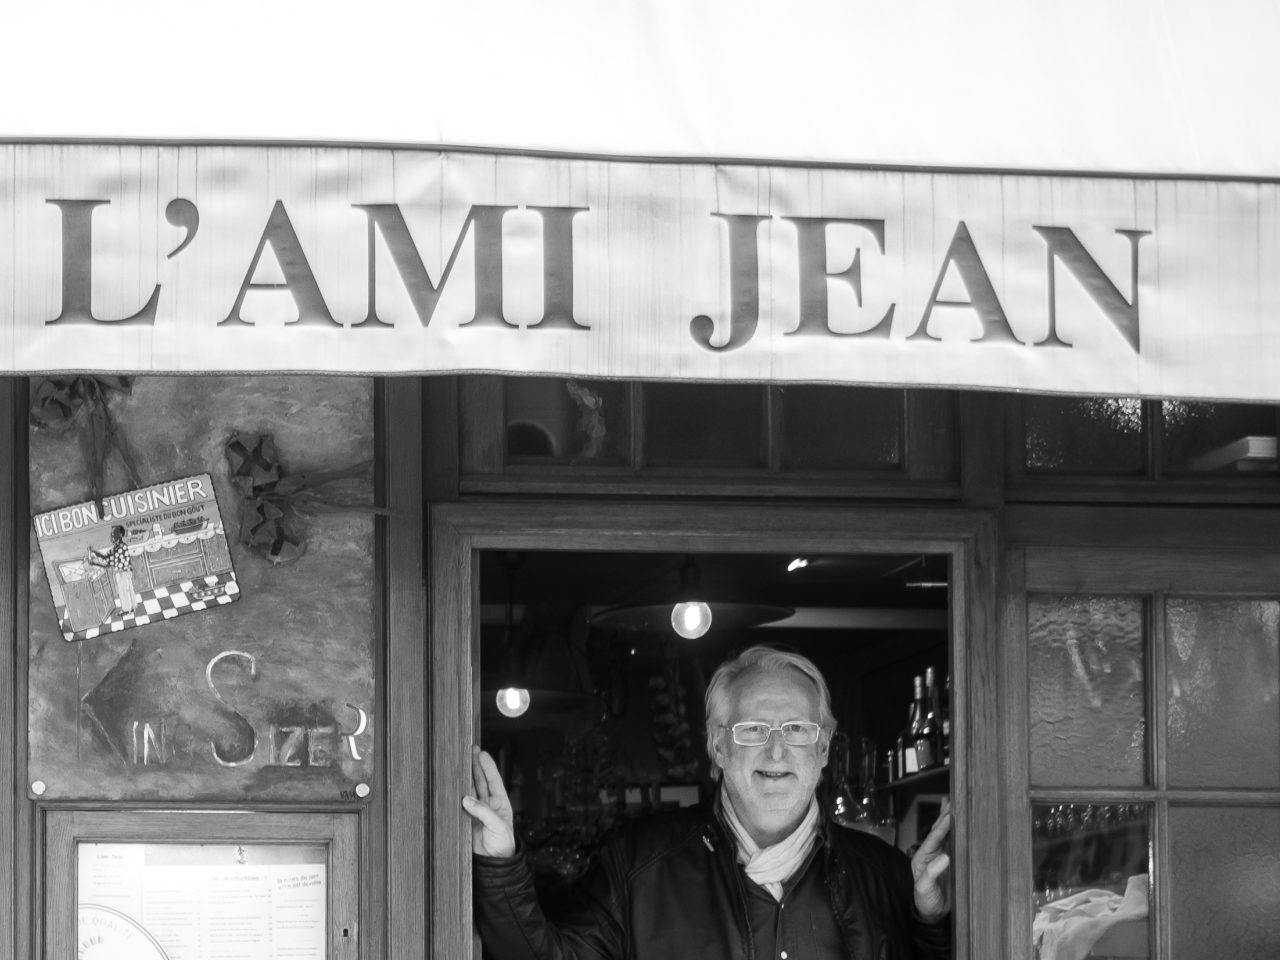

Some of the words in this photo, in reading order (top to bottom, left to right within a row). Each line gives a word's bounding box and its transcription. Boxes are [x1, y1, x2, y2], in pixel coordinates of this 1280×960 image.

[45, 198, 590, 330] L'AMI
[689, 210, 1152, 355] JEAN
[35, 513, 59, 538] ICI
[59, 505, 98, 533] BON
[102, 479, 208, 522] CUISINIER
